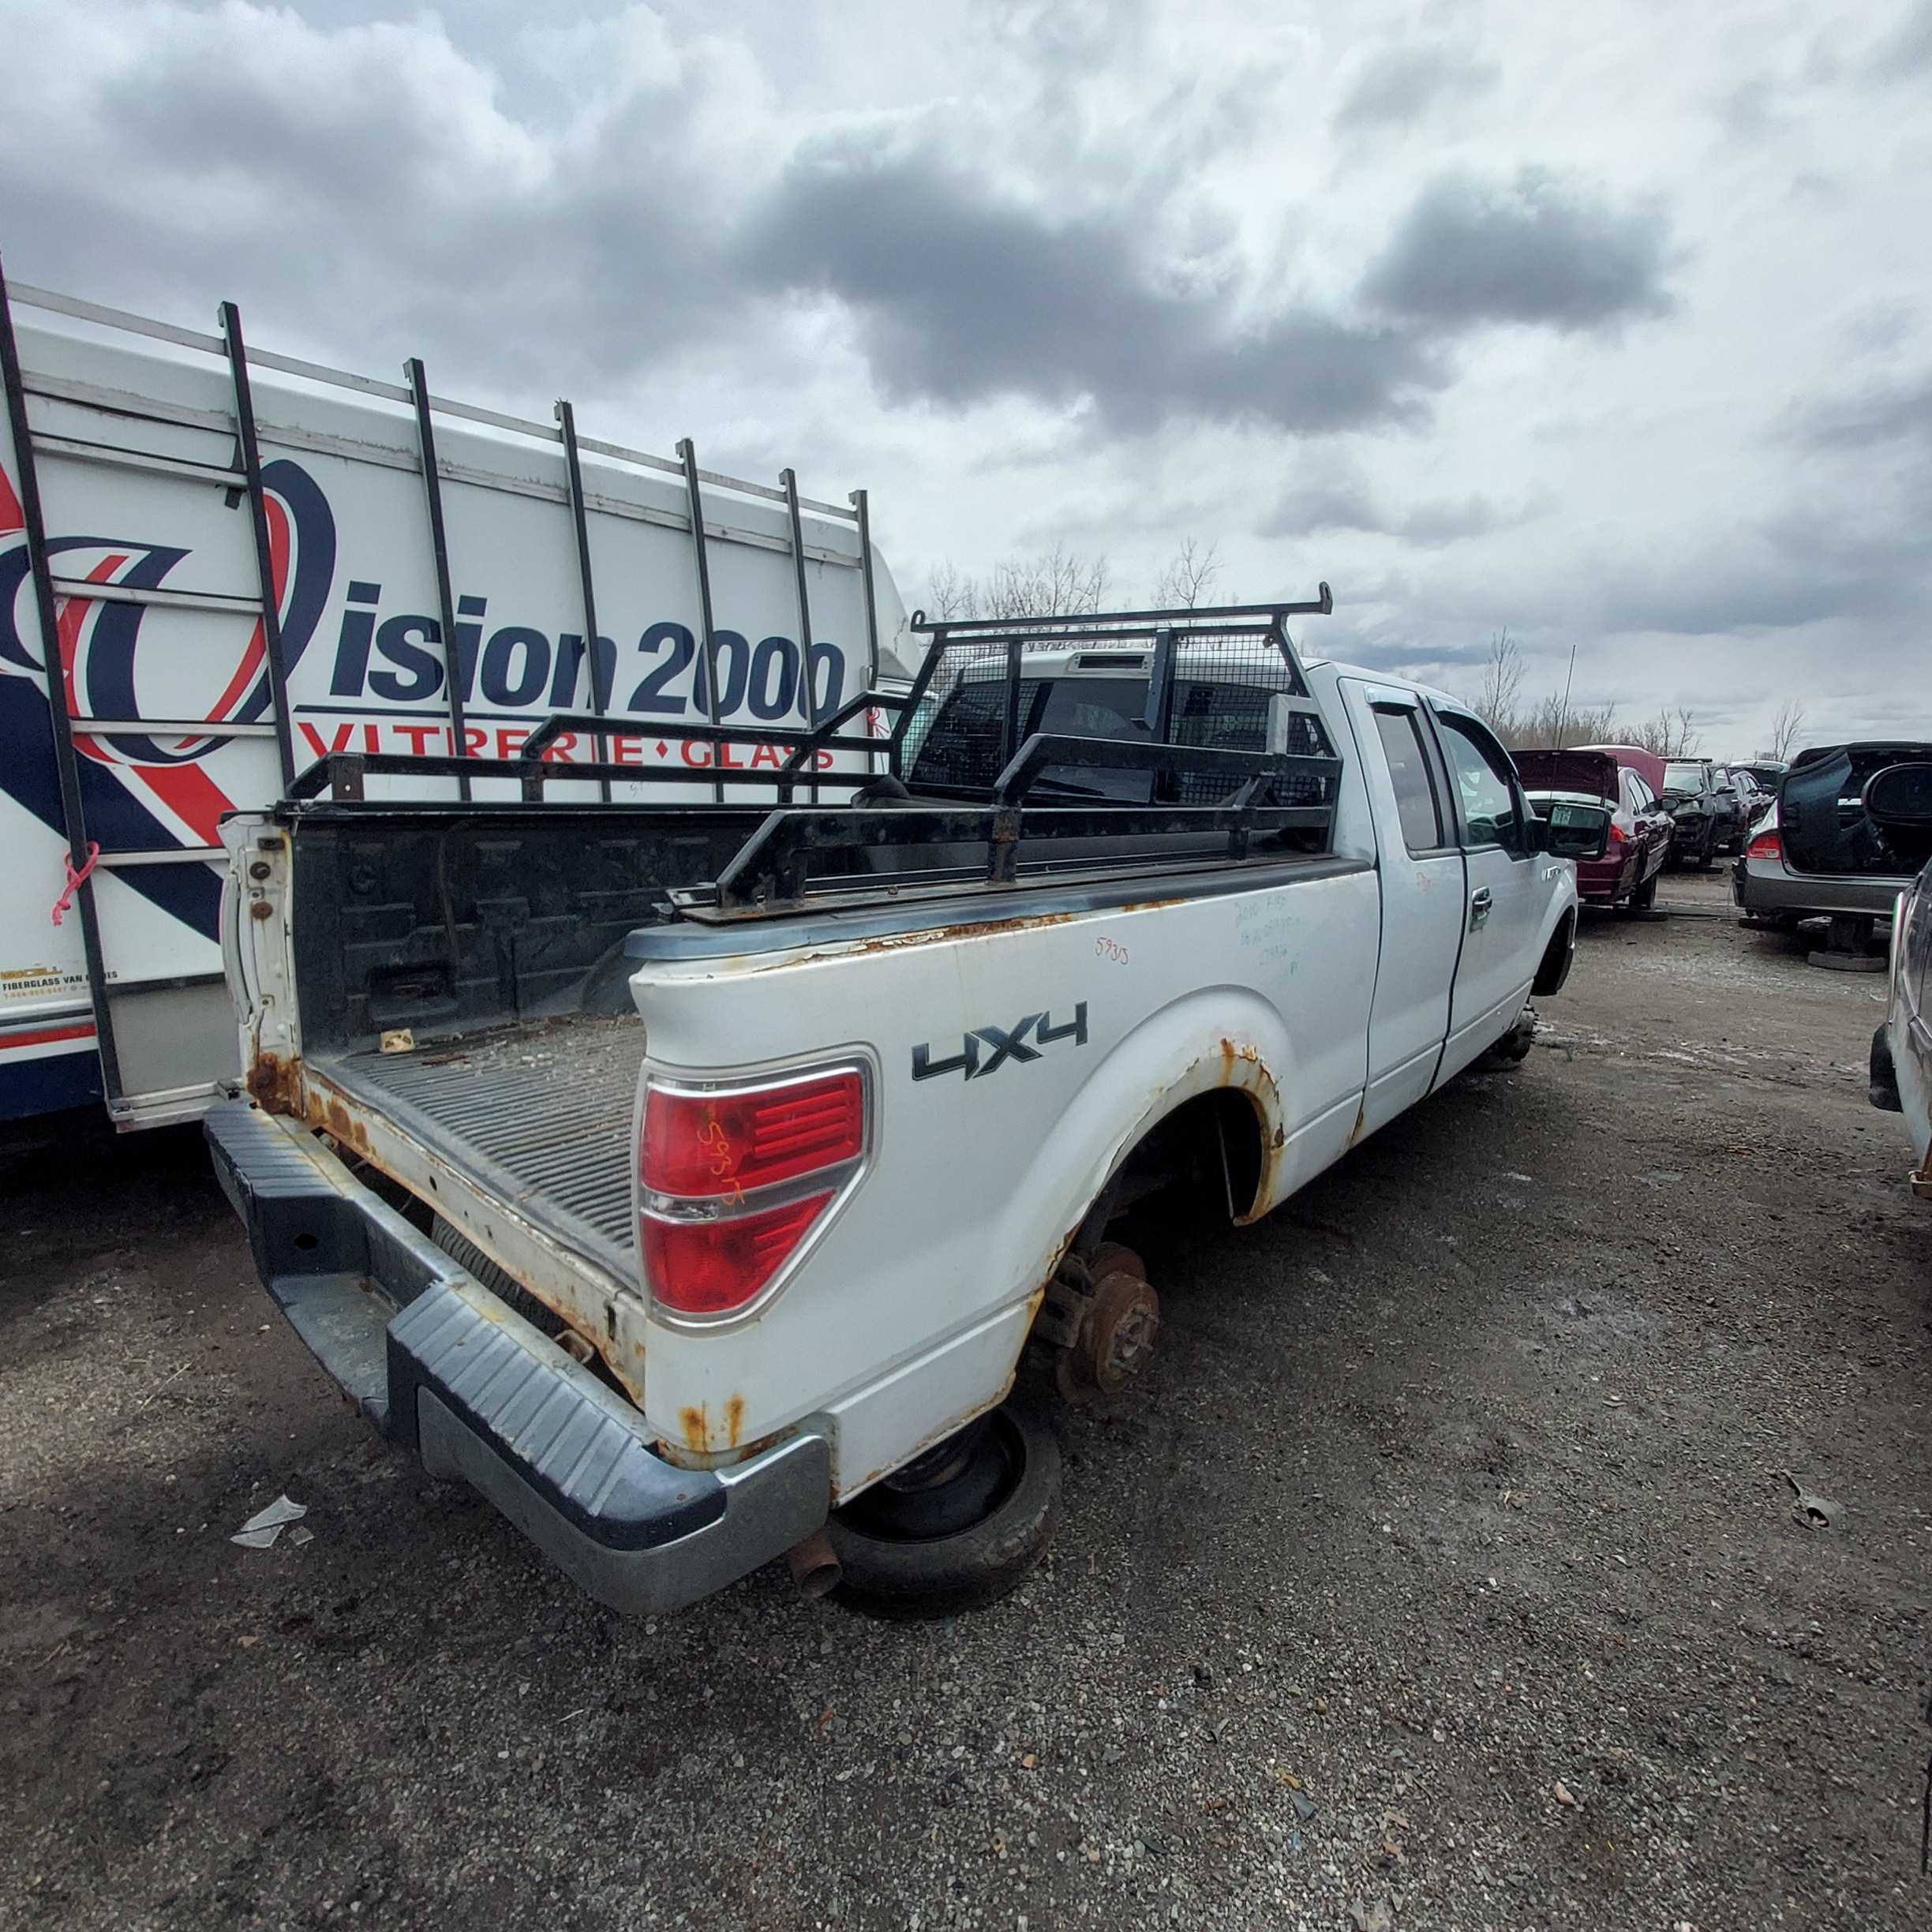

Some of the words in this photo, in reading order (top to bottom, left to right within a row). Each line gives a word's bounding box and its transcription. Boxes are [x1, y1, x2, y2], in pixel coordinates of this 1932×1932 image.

[627, 621, 845, 721] 2000
[2, 978, 60, 991] FIBERGLASS
[63, 975, 82, 983] VAN
